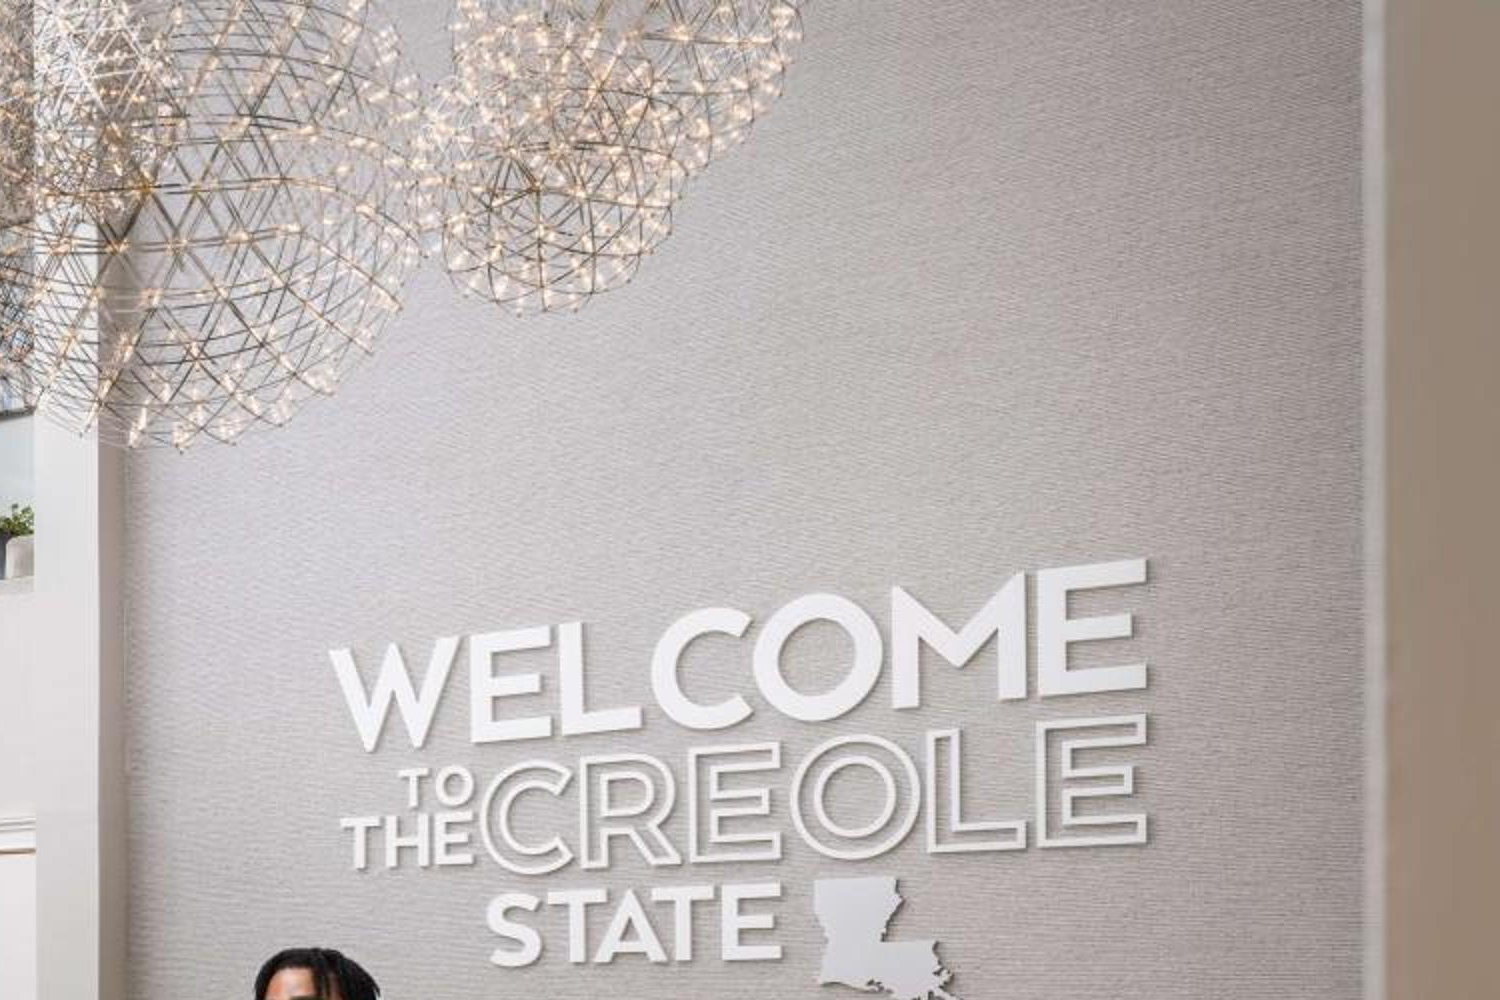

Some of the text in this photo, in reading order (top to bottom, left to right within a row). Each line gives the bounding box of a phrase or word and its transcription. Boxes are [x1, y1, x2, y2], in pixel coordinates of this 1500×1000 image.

[329, 557, 1148, 753] WELCOME
[339, 713, 1148, 875] THE CREOLE
[397, 764, 476, 809] TO
[486, 880, 783, 968] STATE
